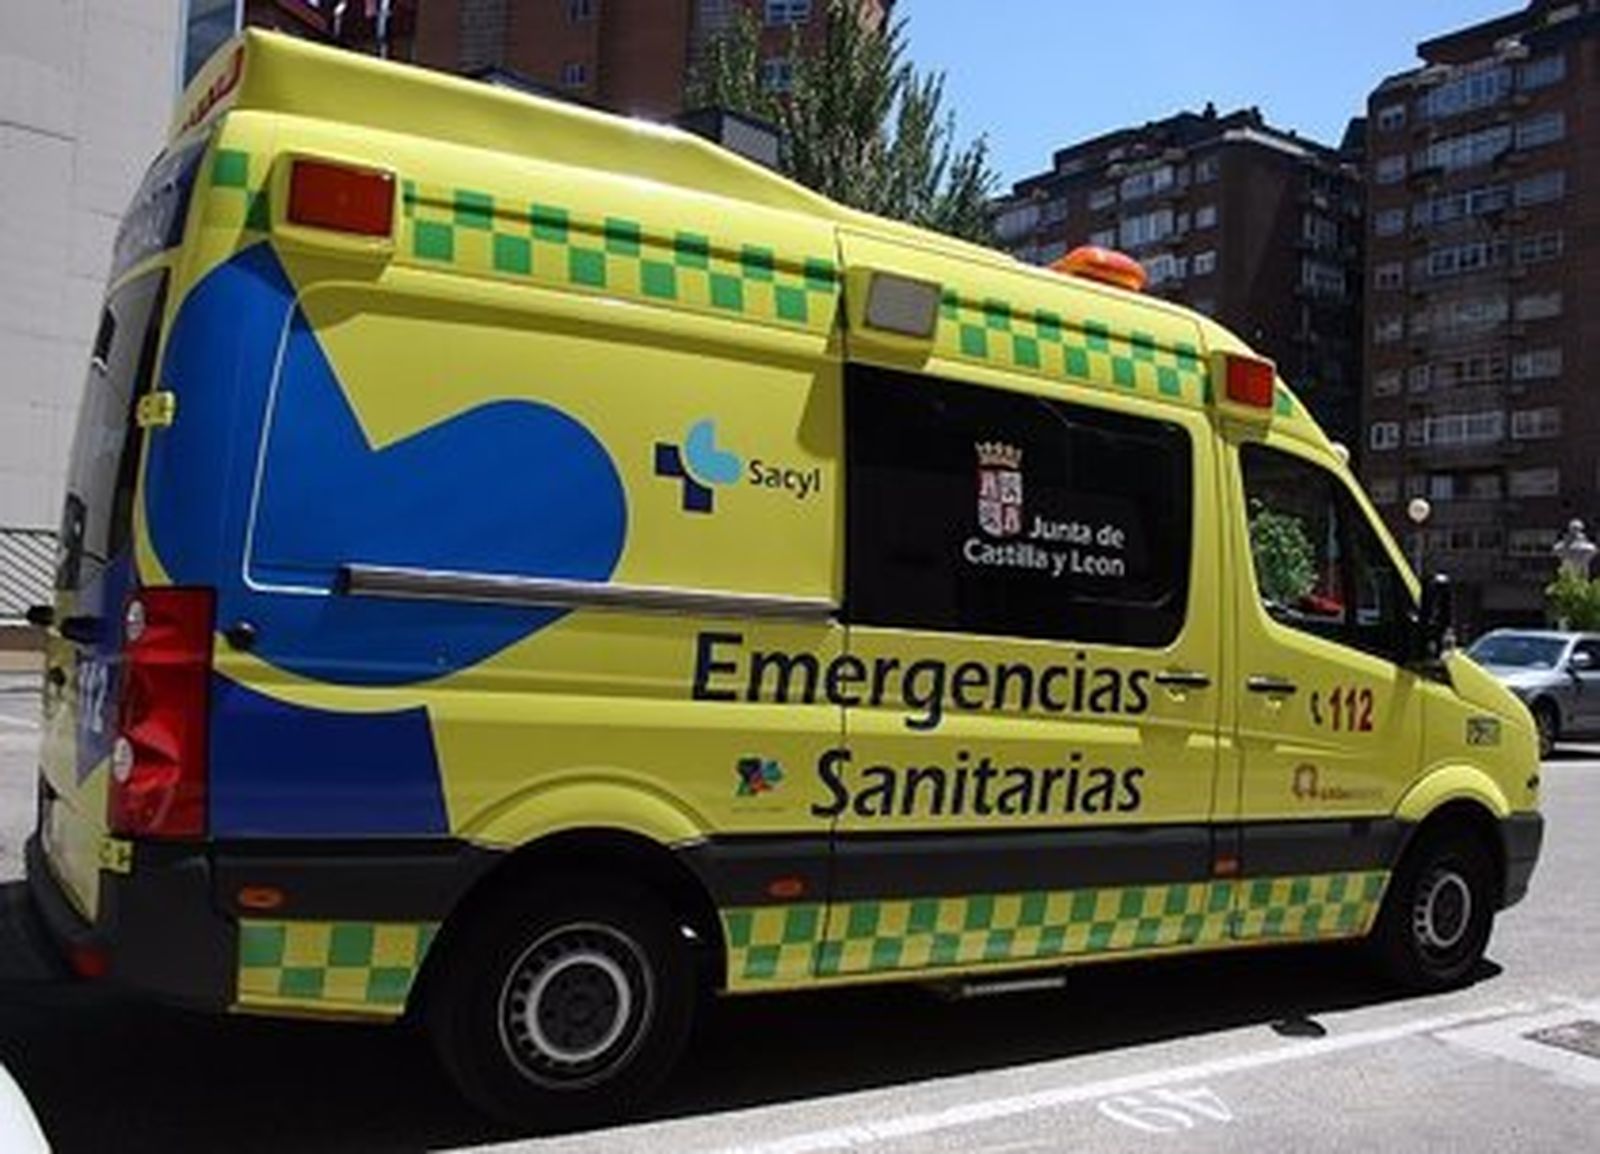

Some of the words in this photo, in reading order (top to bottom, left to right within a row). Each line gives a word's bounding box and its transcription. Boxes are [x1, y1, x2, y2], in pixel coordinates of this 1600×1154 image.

[749, 459, 821, 500] Sacyl
[1029, 515, 1092, 544] Junta
[1096, 524, 1125, 548] de
[963, 537, 1049, 569] Castilla
[1051, 552, 1067, 577] y
[692, 632, 1149, 730] Emergencias
[1329, 685, 1375, 731] 112
[811, 748, 1145, 818] Sanitarias
